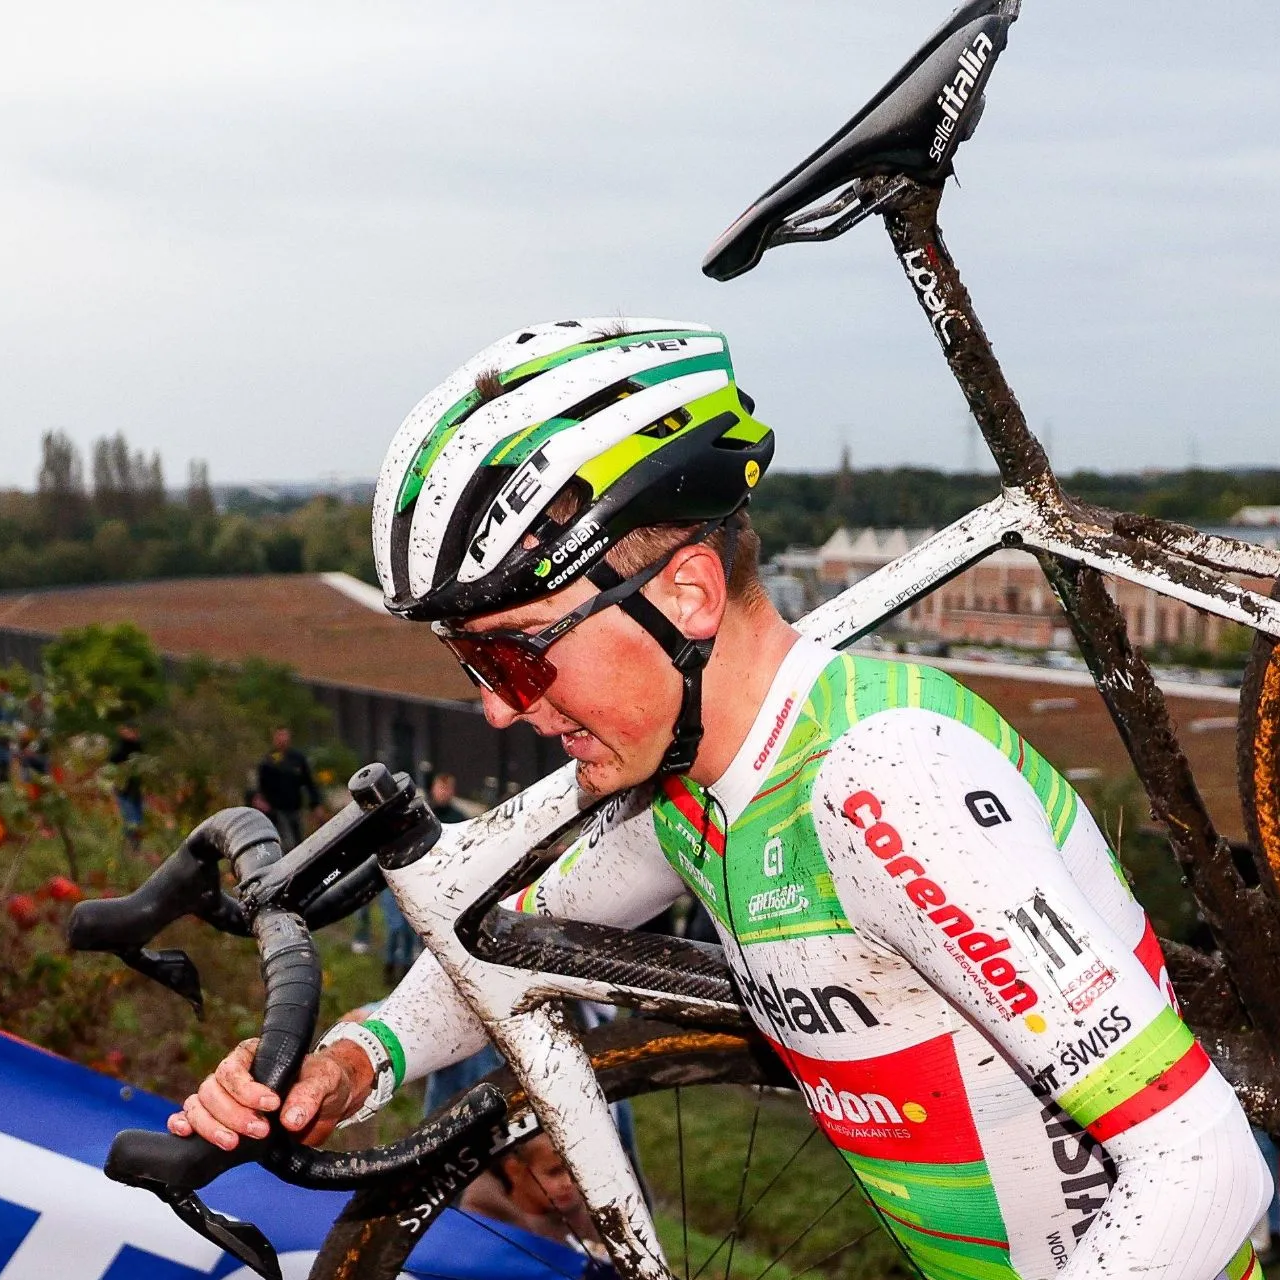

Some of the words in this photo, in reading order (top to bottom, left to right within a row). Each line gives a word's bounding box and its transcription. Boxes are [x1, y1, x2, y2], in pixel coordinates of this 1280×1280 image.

[466, 440, 552, 564] MET
[551, 520, 601, 565] crelan
[884, 552, 971, 611] SUPERPRESTIGE
[322, 868, 342, 886] BOX
[1006, 892, 1083, 971] 11
[1060, 1005, 1132, 1077] SWISS
